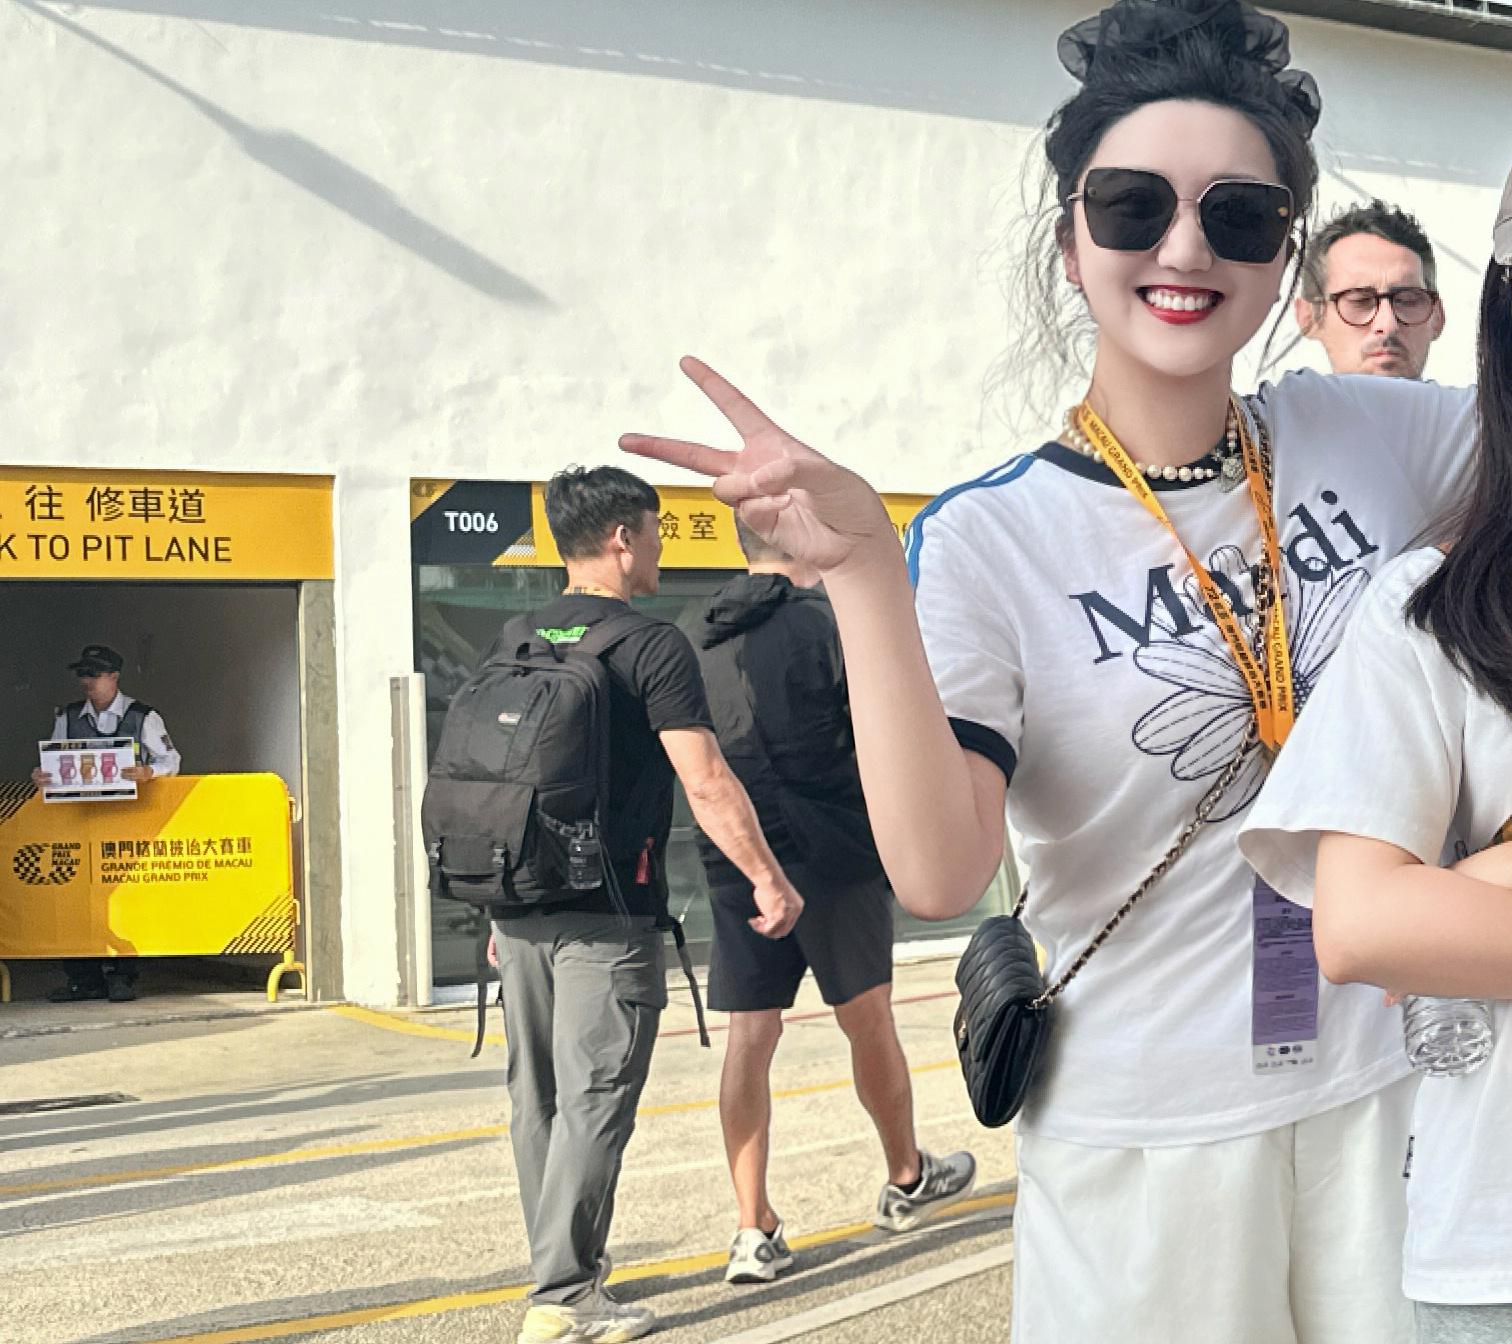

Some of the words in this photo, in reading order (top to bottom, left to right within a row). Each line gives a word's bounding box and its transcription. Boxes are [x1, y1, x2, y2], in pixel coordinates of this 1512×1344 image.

[1108, 445, 1133, 479] GRAND
[25, 485, 65, 522] 往
[85, 486, 206, 523] 修車道
[444, 512, 499, 533] T006
[27, 534, 70, 561] TO
[83, 535, 134, 562] PIT
[146, 536, 232, 562] LANE
[1272, 641, 1286, 684] GRAND
[1276, 686, 1288, 711] PRIX
[101, 861, 148, 873] GRANDE
[197, 859, 211, 870] DE
[214, 858, 253, 869] MACAU
[102, 873, 140, 885] MACAU
[142, 872, 181, 884] GRAND
[184, 871, 209, 882] PRIX
